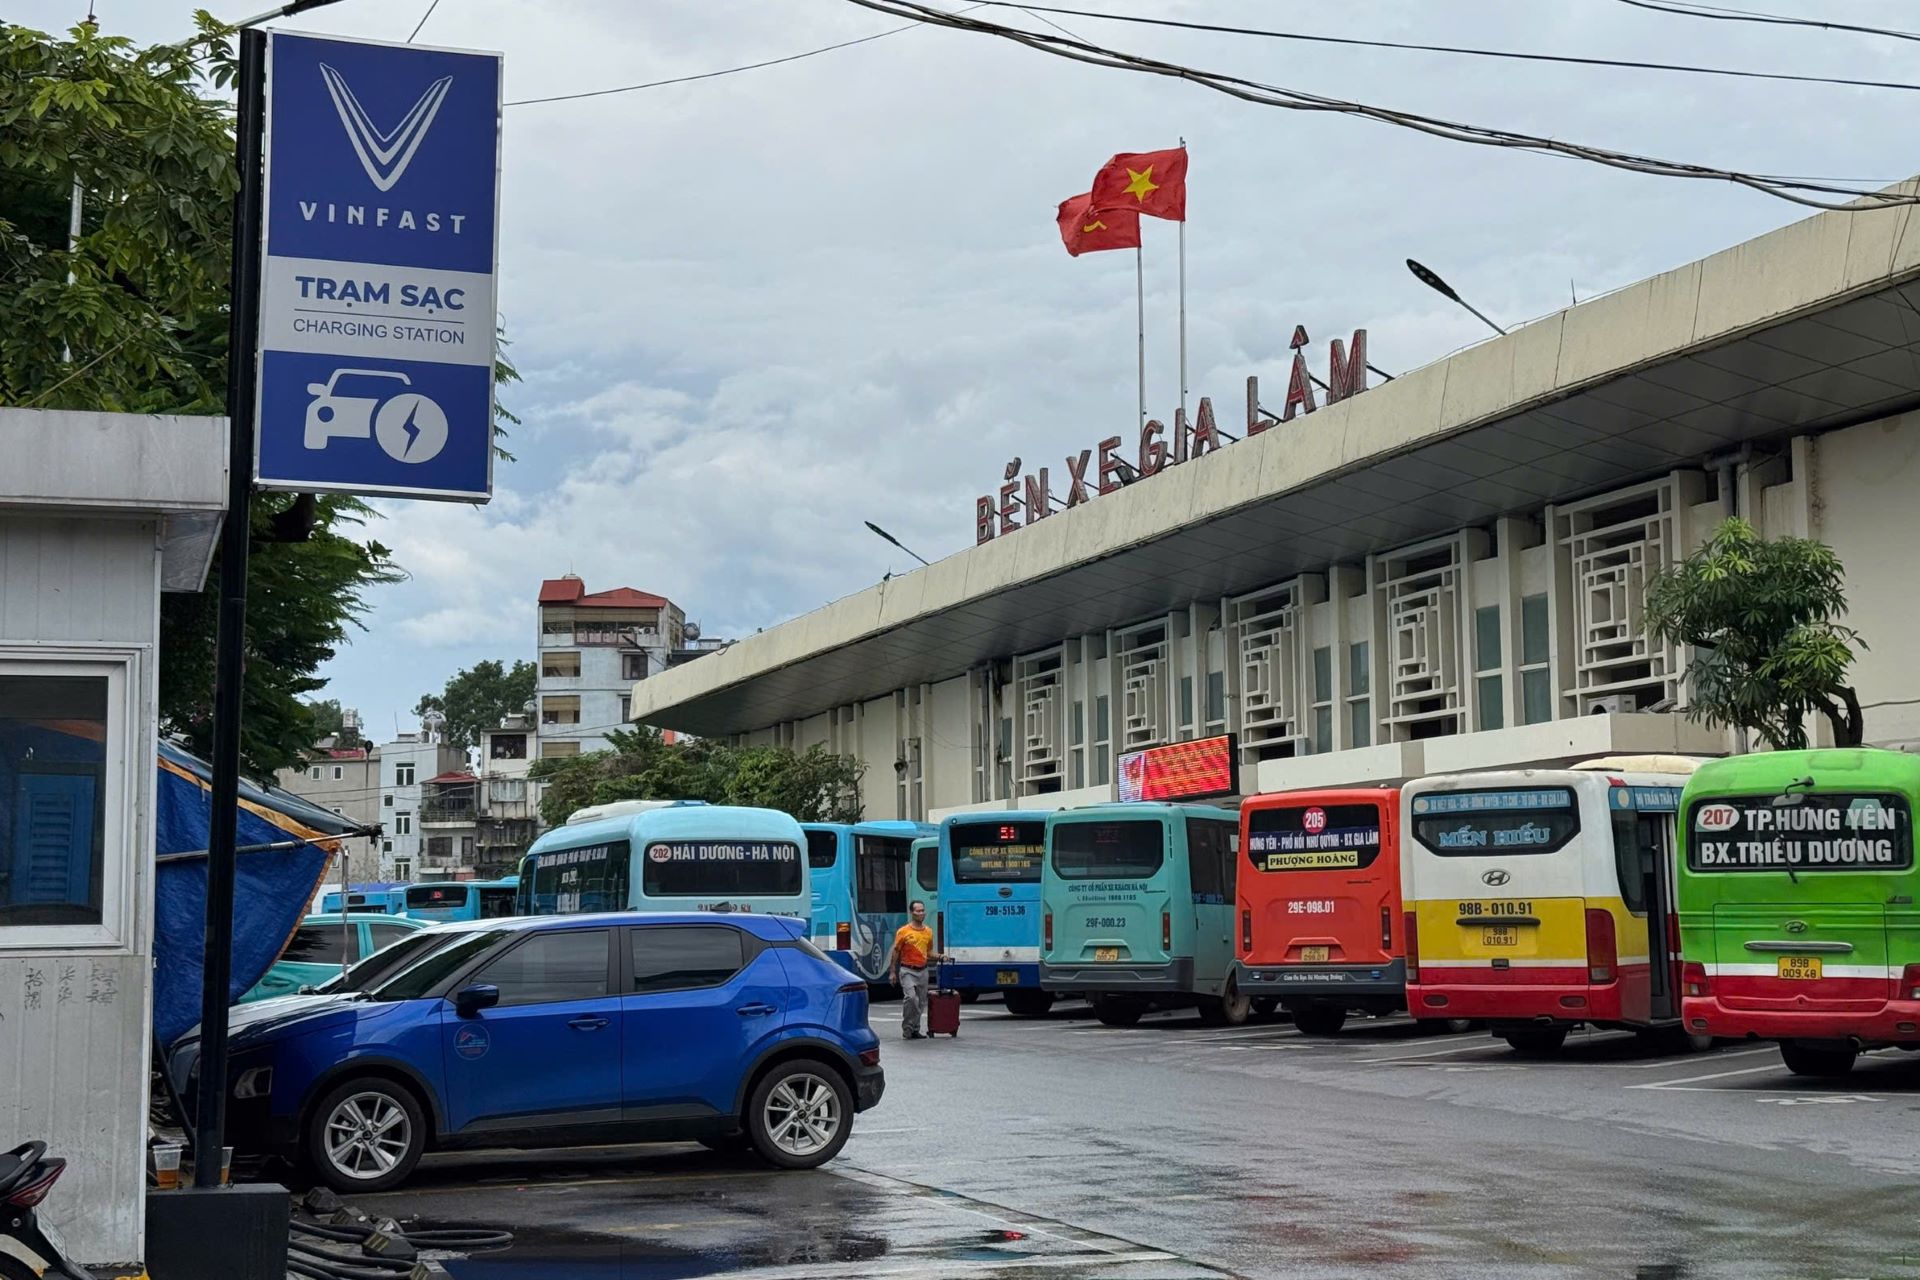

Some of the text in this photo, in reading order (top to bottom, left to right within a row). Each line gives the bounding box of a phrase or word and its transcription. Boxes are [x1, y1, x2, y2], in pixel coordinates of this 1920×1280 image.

[299, 200, 467, 235] VINFAST
[294, 275, 466, 315] TRẠM SẠC
[293, 317, 465, 346] CHARGING STATION
[1065, 435, 1123, 509] XE
[1139, 396, 1221, 477] GIA
[1246, 324, 1368, 437] LÂM
[1305, 812, 1324, 829] 205
[1703, 804, 1896, 831] 207 TP.HƯNG YÊN
[1265, 835, 1277, 850] YÊN
[1344, 833, 1353, 846] BX
[1353, 832, 1364, 846] GIA
[1808, 837, 1893, 863] DƯƠNG
[653, 847, 669, 859] 202
[773, 845, 795, 863] NỘI
[1269, 856, 1314, 868] PHƯỢNG
[1486, 936, 1513, 945] 010.91
[1790, 958, 1809, 968] 89B
[1782, 968, 1817, 979] 009.48
